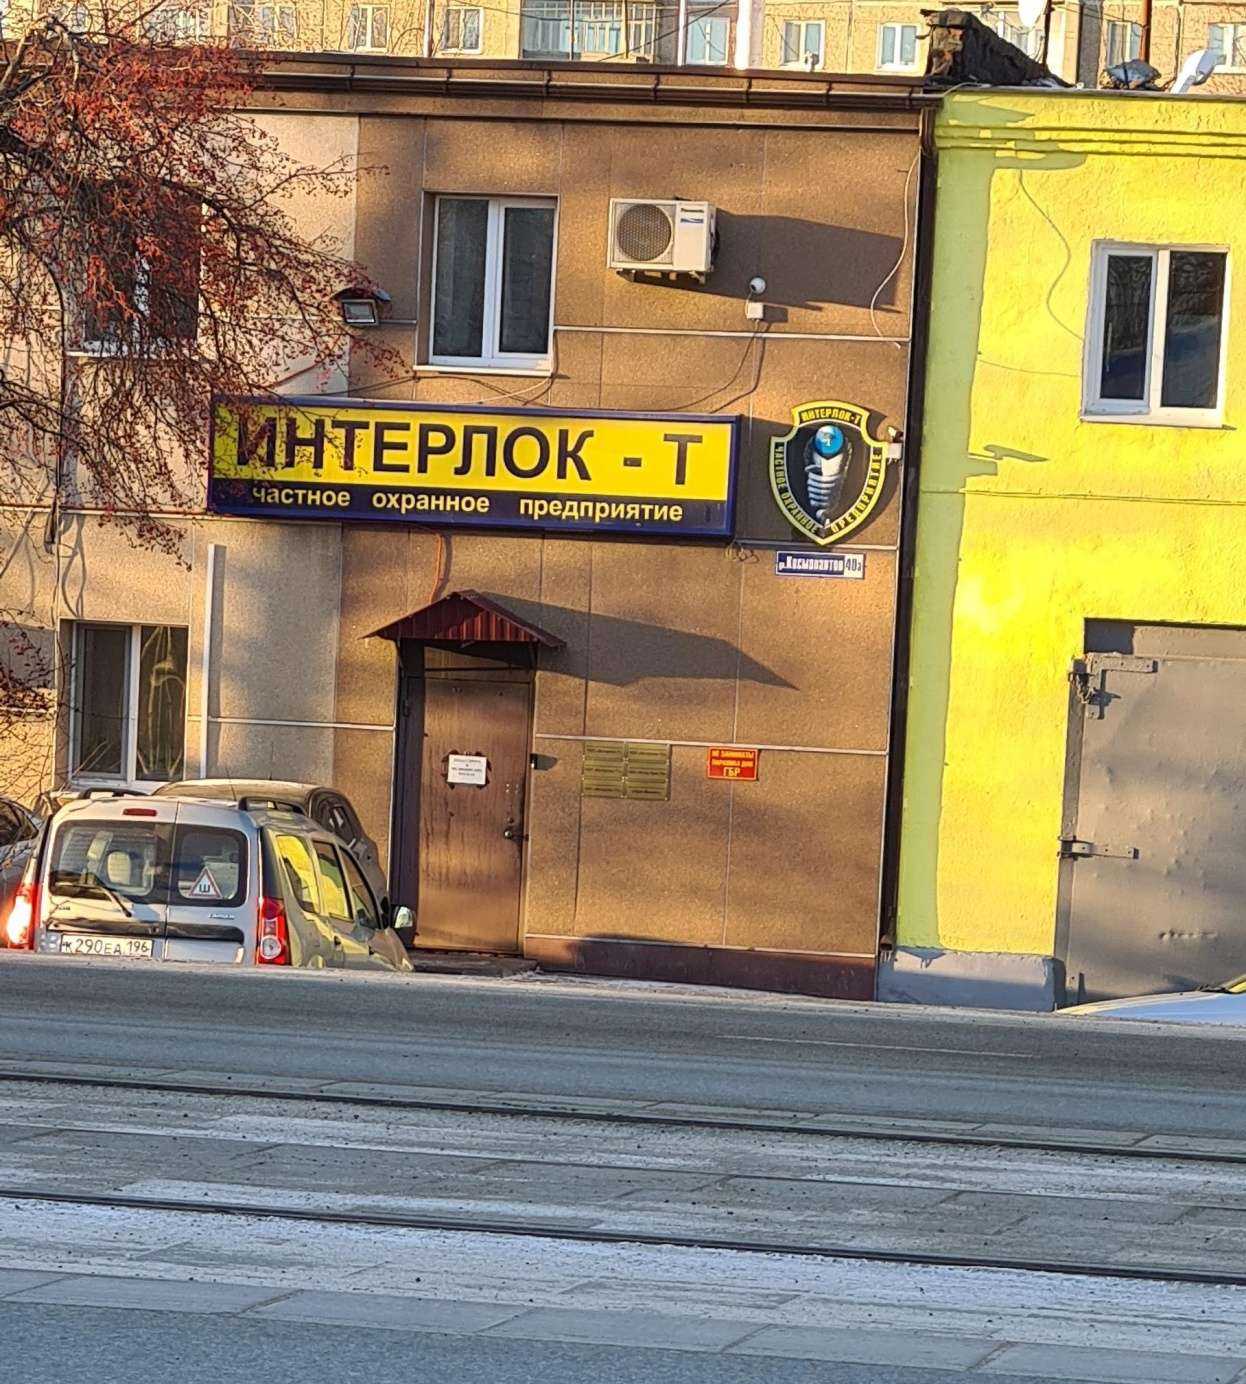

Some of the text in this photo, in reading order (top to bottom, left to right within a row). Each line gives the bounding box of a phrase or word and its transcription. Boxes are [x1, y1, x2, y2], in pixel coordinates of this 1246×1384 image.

[237, 414, 594, 481] ИНТЕРЛОК
[664, 433, 703, 485] Т
[253, 486, 683, 522] частное охранное предприятие
